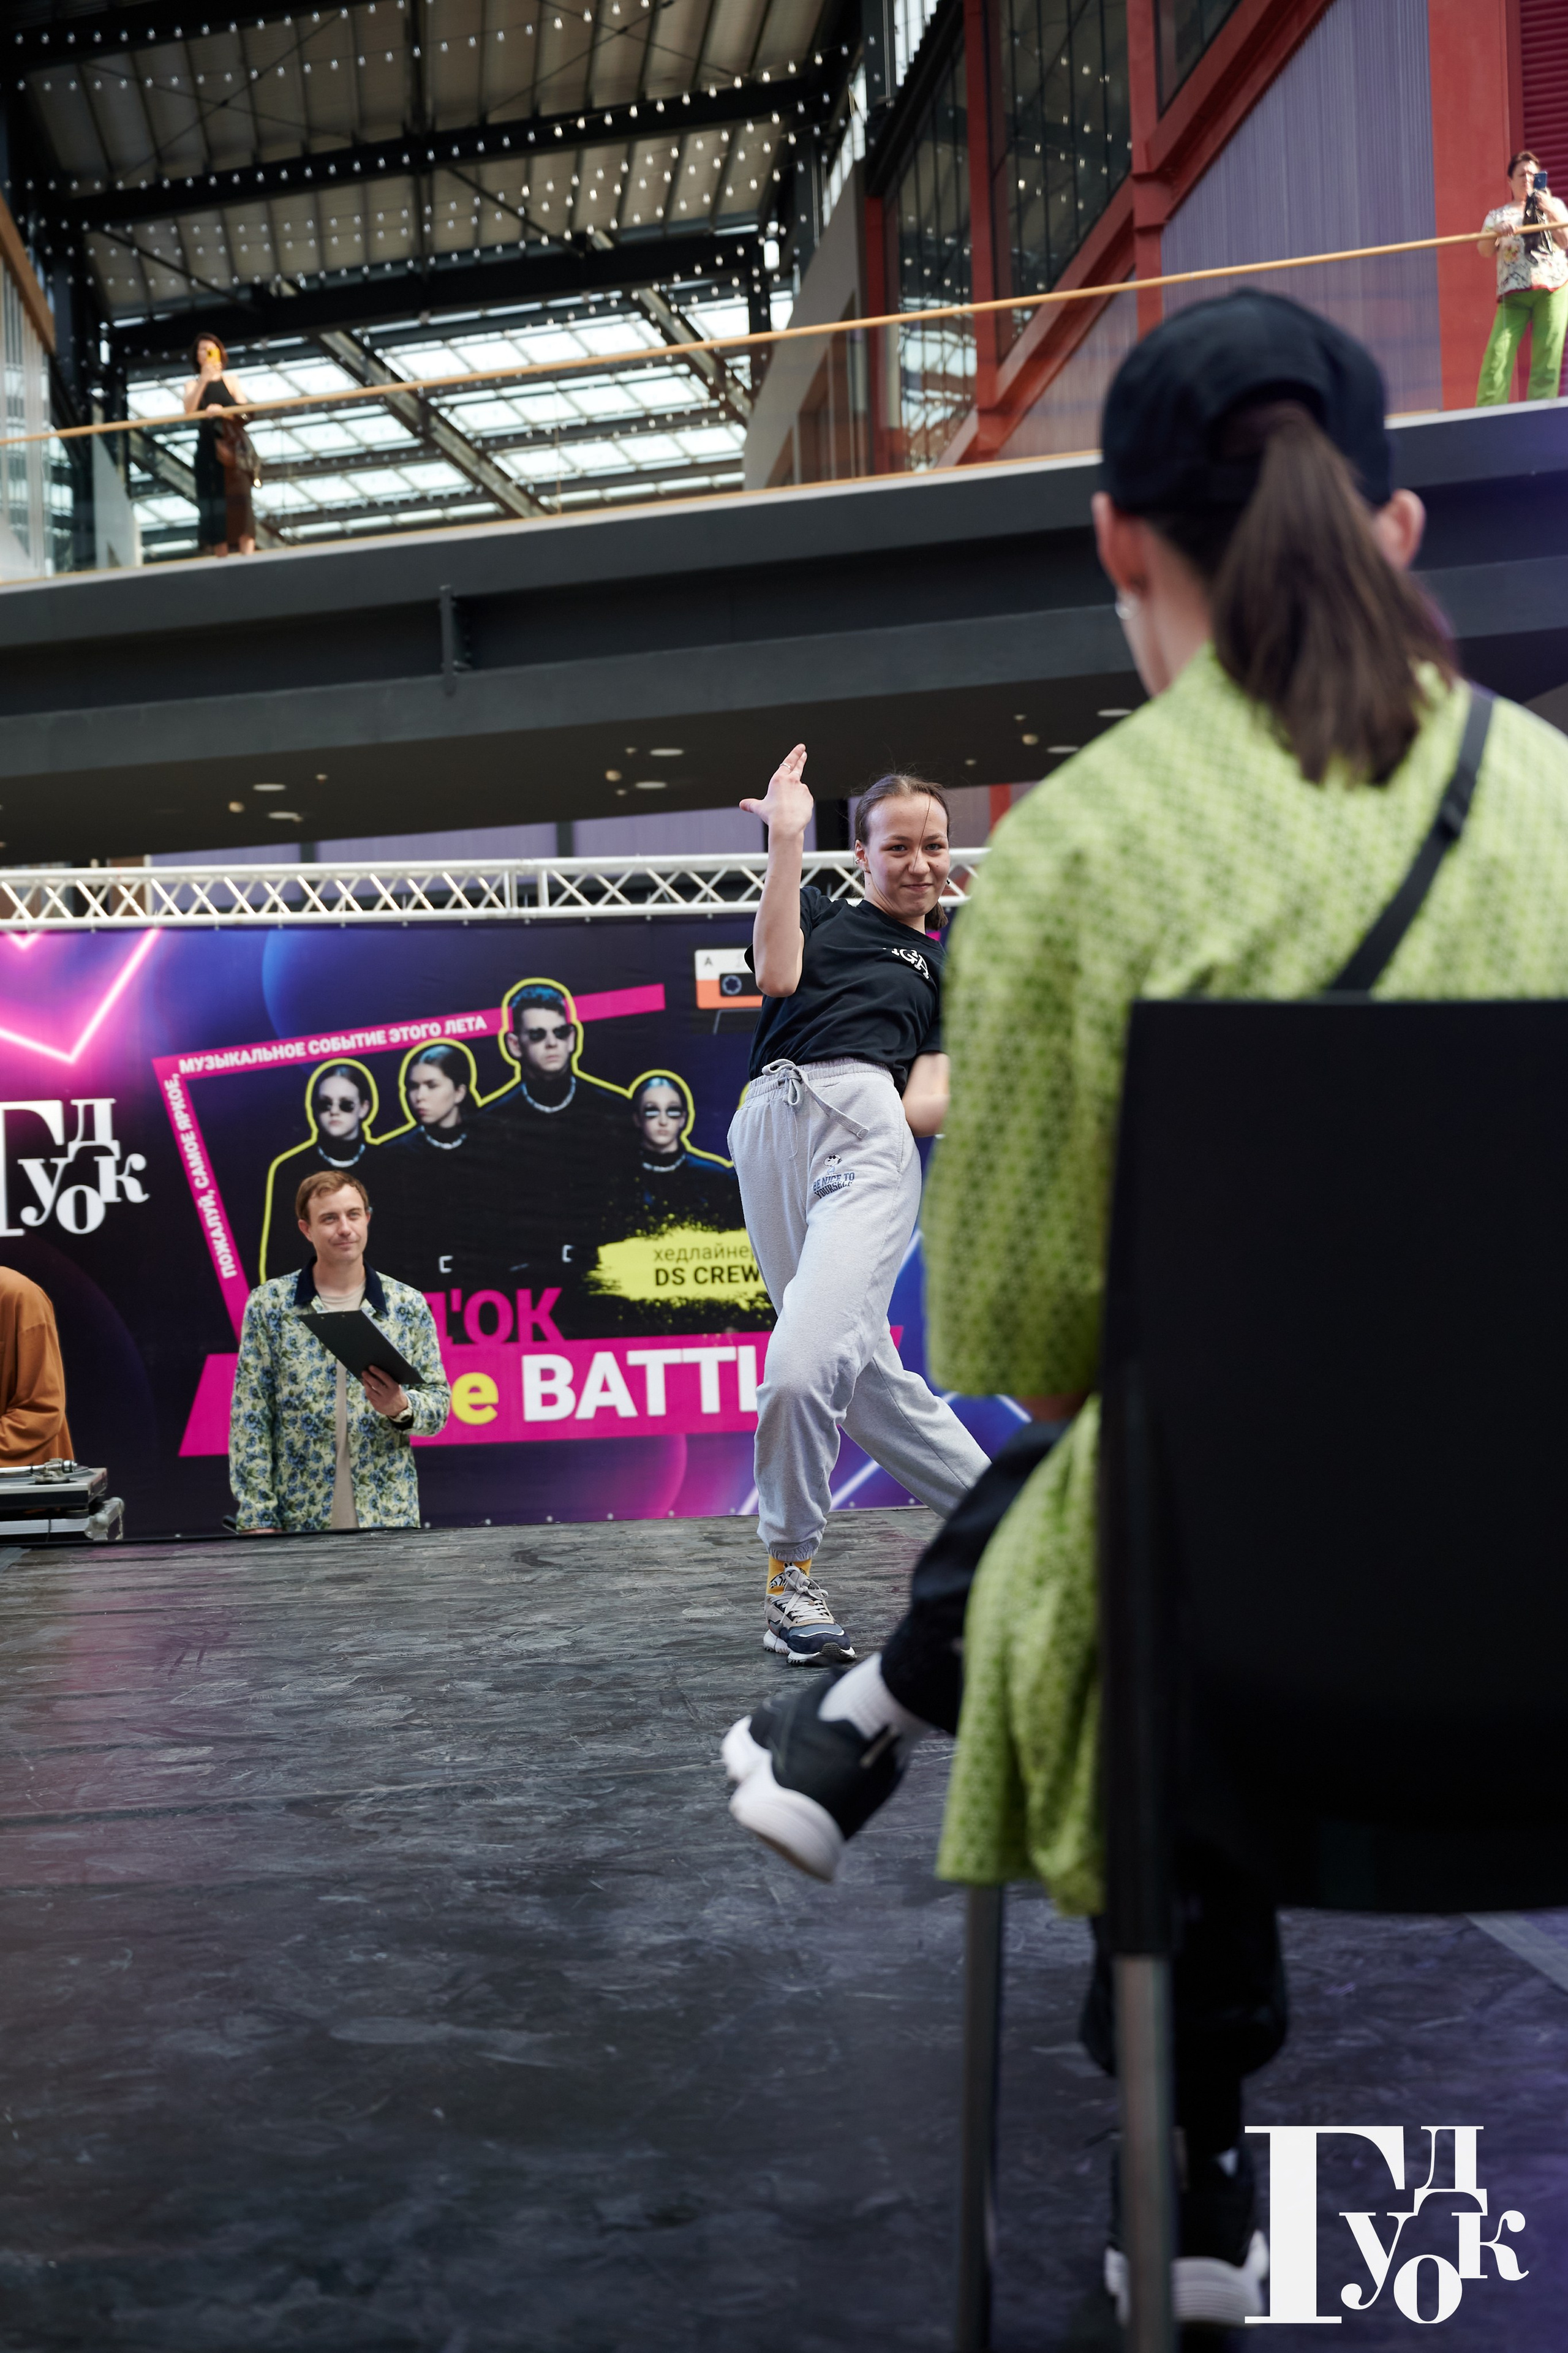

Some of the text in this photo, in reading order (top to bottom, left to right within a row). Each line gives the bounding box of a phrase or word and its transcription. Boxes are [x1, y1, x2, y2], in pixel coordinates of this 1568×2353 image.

[179, 1015, 487, 1074] МУЗЫКАЛЬНОЕ СОБЫТИЕ ЭТОГО ЛЕТА
[164, 1073, 237, 1279] ПОЖАЛУЙ, САМОЕ ЯРКОЕ,
[813, 1172, 855, 1191] BE NICE TO
[814, 1181, 853, 1199] YOURSELF
[655, 1264, 760, 1286] DS CREW
[521, 1345, 757, 1422] BATTL
